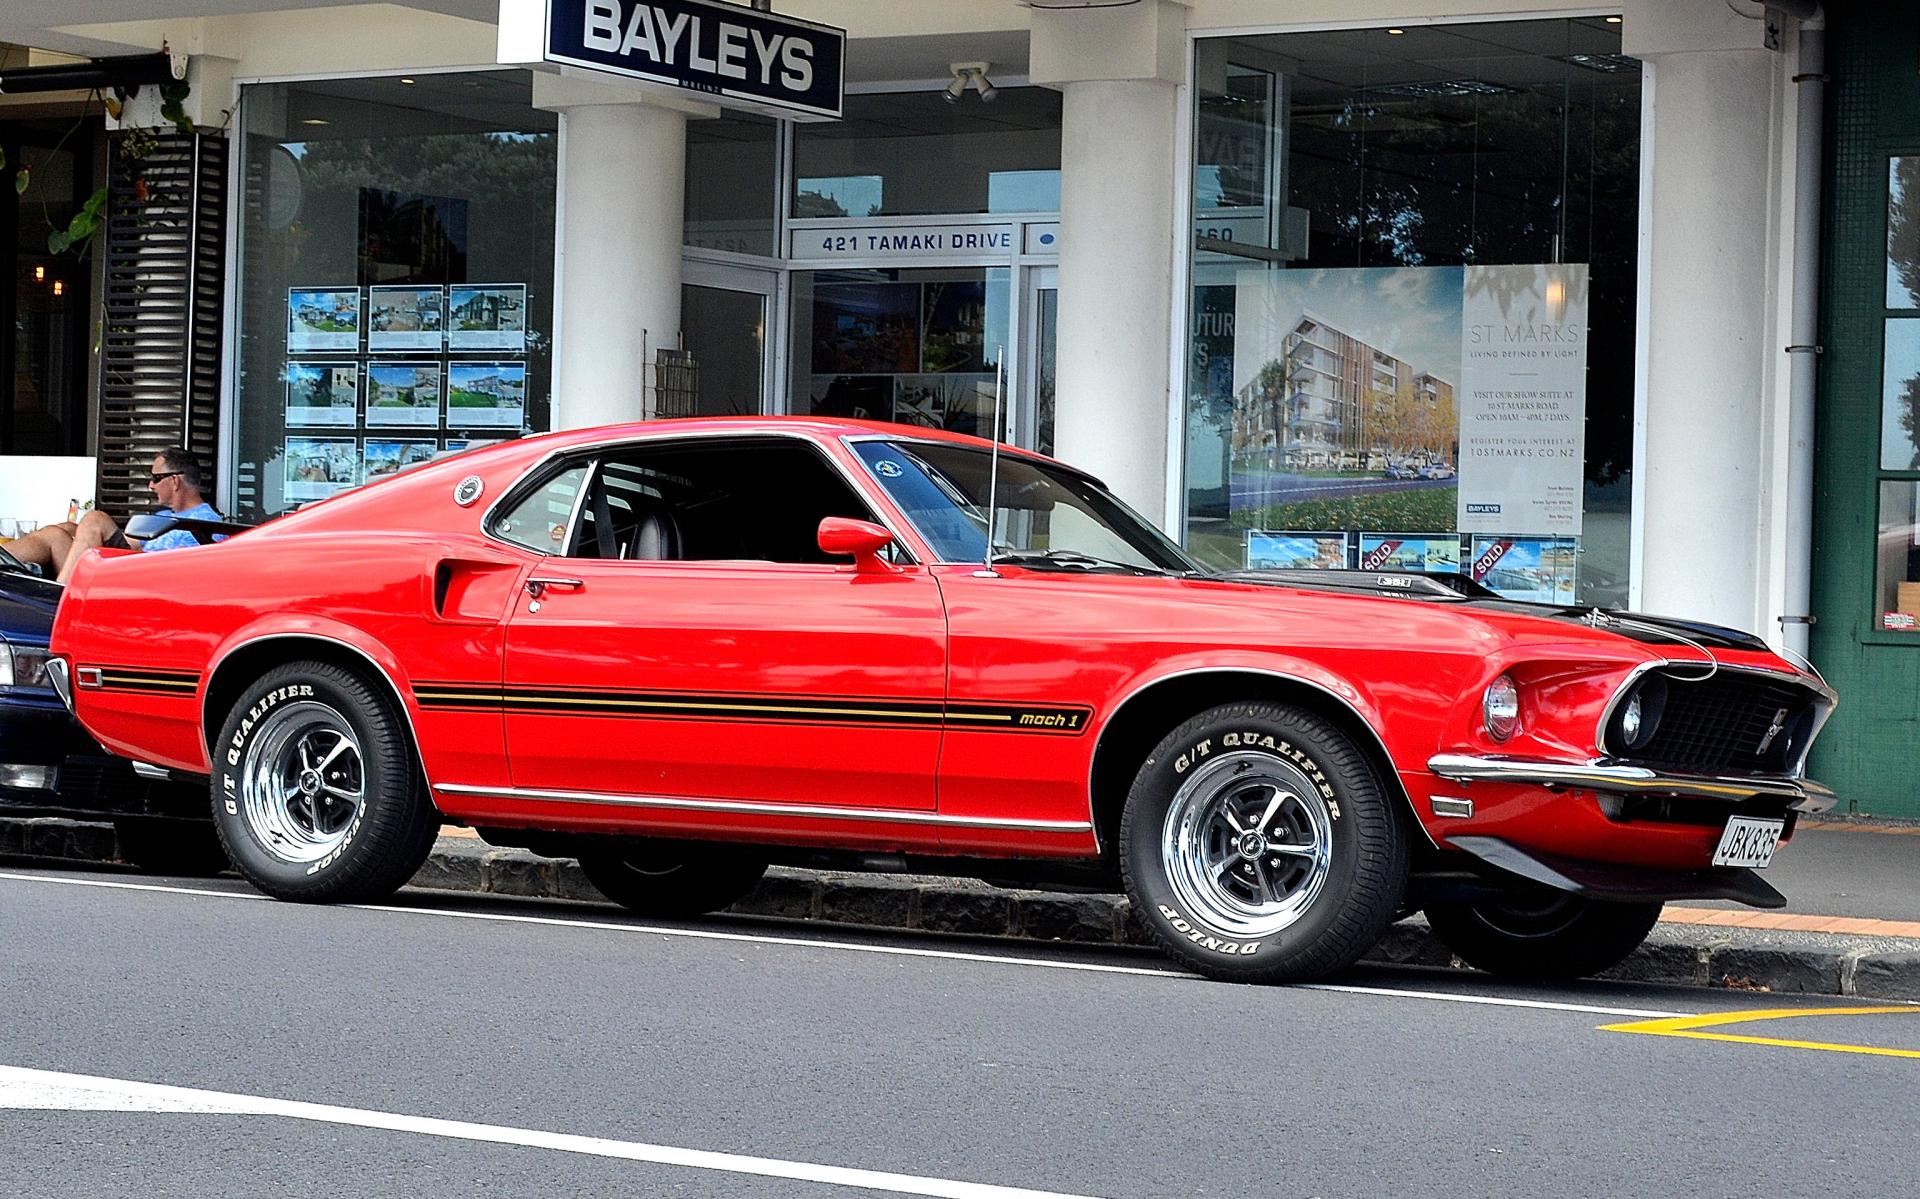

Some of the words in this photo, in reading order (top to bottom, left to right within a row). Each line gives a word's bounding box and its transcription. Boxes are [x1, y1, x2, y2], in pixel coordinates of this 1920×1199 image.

[583, 0, 814, 92] BAYLEYS
[822, 235, 858, 252] 421
[868, 234, 943, 251] TAMAKI
[951, 232, 1011, 249] DRIVE
[1471, 324, 1496, 344] ST
[1504, 324, 1579, 344] MARKS
[1470, 350, 1498, 358] LIVING
[1502, 350, 1537, 358] DEFINED
[1541, 350, 1551, 358] BY
[1554, 350, 1578, 358] LIGHT
[1473, 391, 1494, 399] VISIT
[1495, 391, 1513, 399] OUR
[1513, 391, 1538, 399] SHOW
[1539, 391, 1562, 399] SUITE
[1563, 391, 1574, 399] AT
[1496, 402, 1505, 410] ST
[1507, 402, 1535, 410] MARKS
[1476, 413, 1498, 421] OPEN
[1364, 544, 1392, 570] SOLD
[1476, 544, 1504, 574] SOLD
[227, 685, 314, 767] QUALIFIER
[1019, 713, 1066, 727] mach
[1068, 714, 1079, 727] 1
[1174, 739, 1211, 774] G/T
[1223, 732, 1341, 821] QUALIFIER
[224, 773, 239, 816] G/T
[306, 800, 367, 876] DUNLOP
[1721, 825, 1780, 861] JBK835
[1158, 904, 1262, 956] DUNLOP
